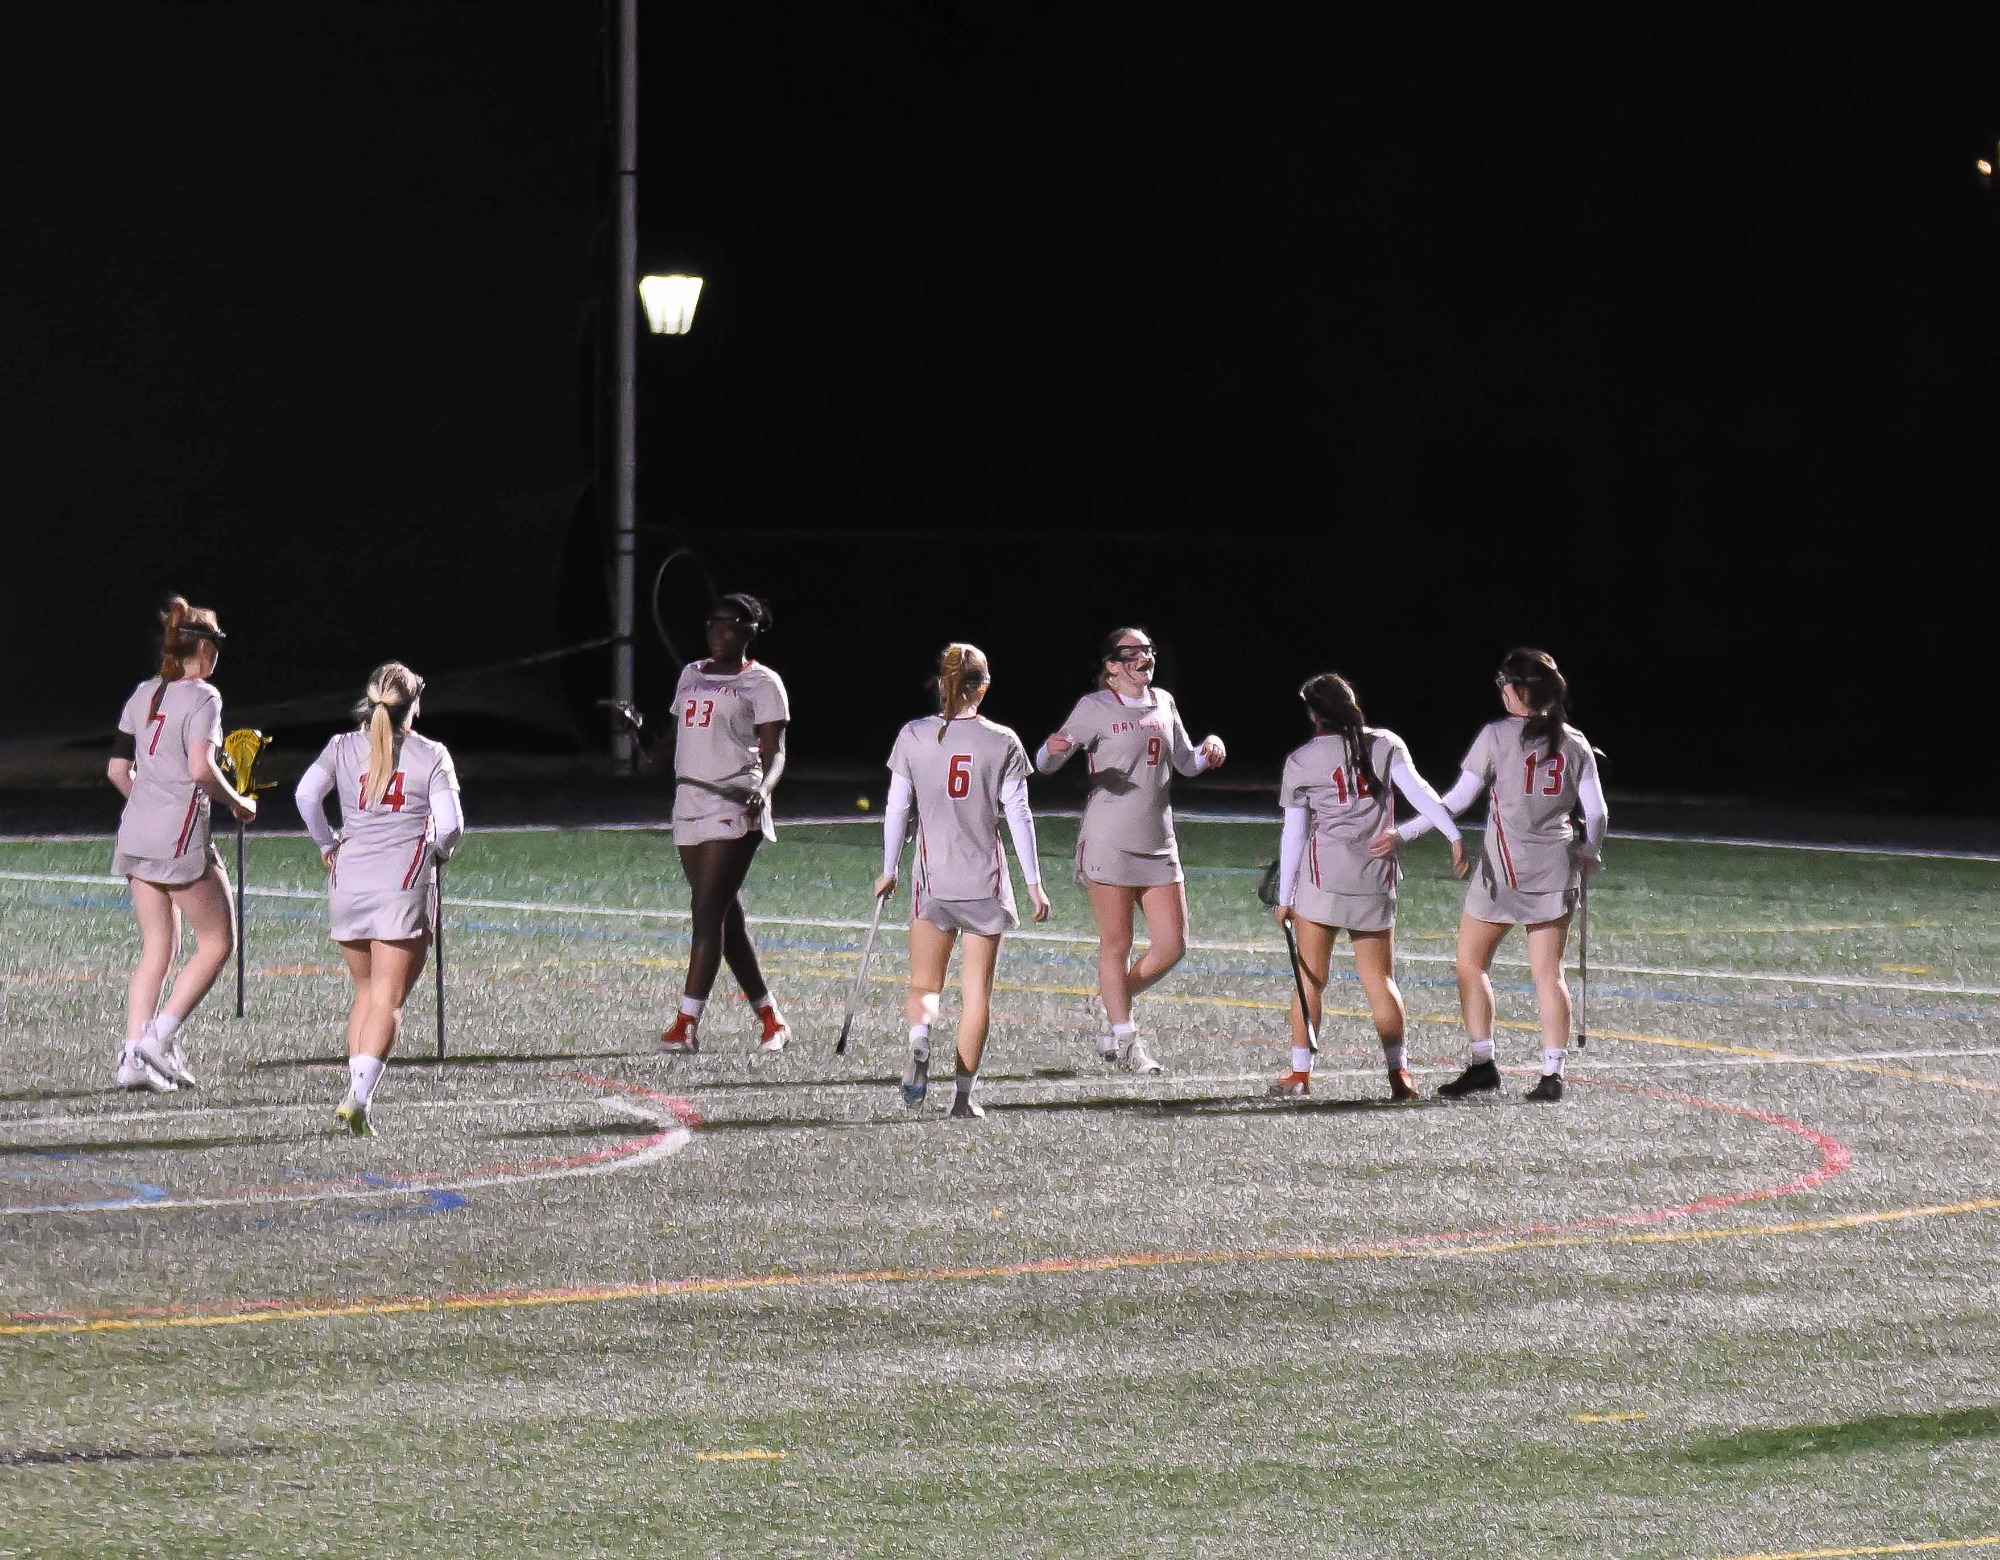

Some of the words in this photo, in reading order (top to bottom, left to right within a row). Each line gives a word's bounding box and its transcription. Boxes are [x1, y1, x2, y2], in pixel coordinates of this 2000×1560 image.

[148, 713, 167, 757] 7
[685, 699, 714, 728] 23
[1146, 737, 1161, 766] 9
[358, 770, 406, 812] 14
[947, 753, 973, 800] 6
[1524, 751, 1565, 796] 13
